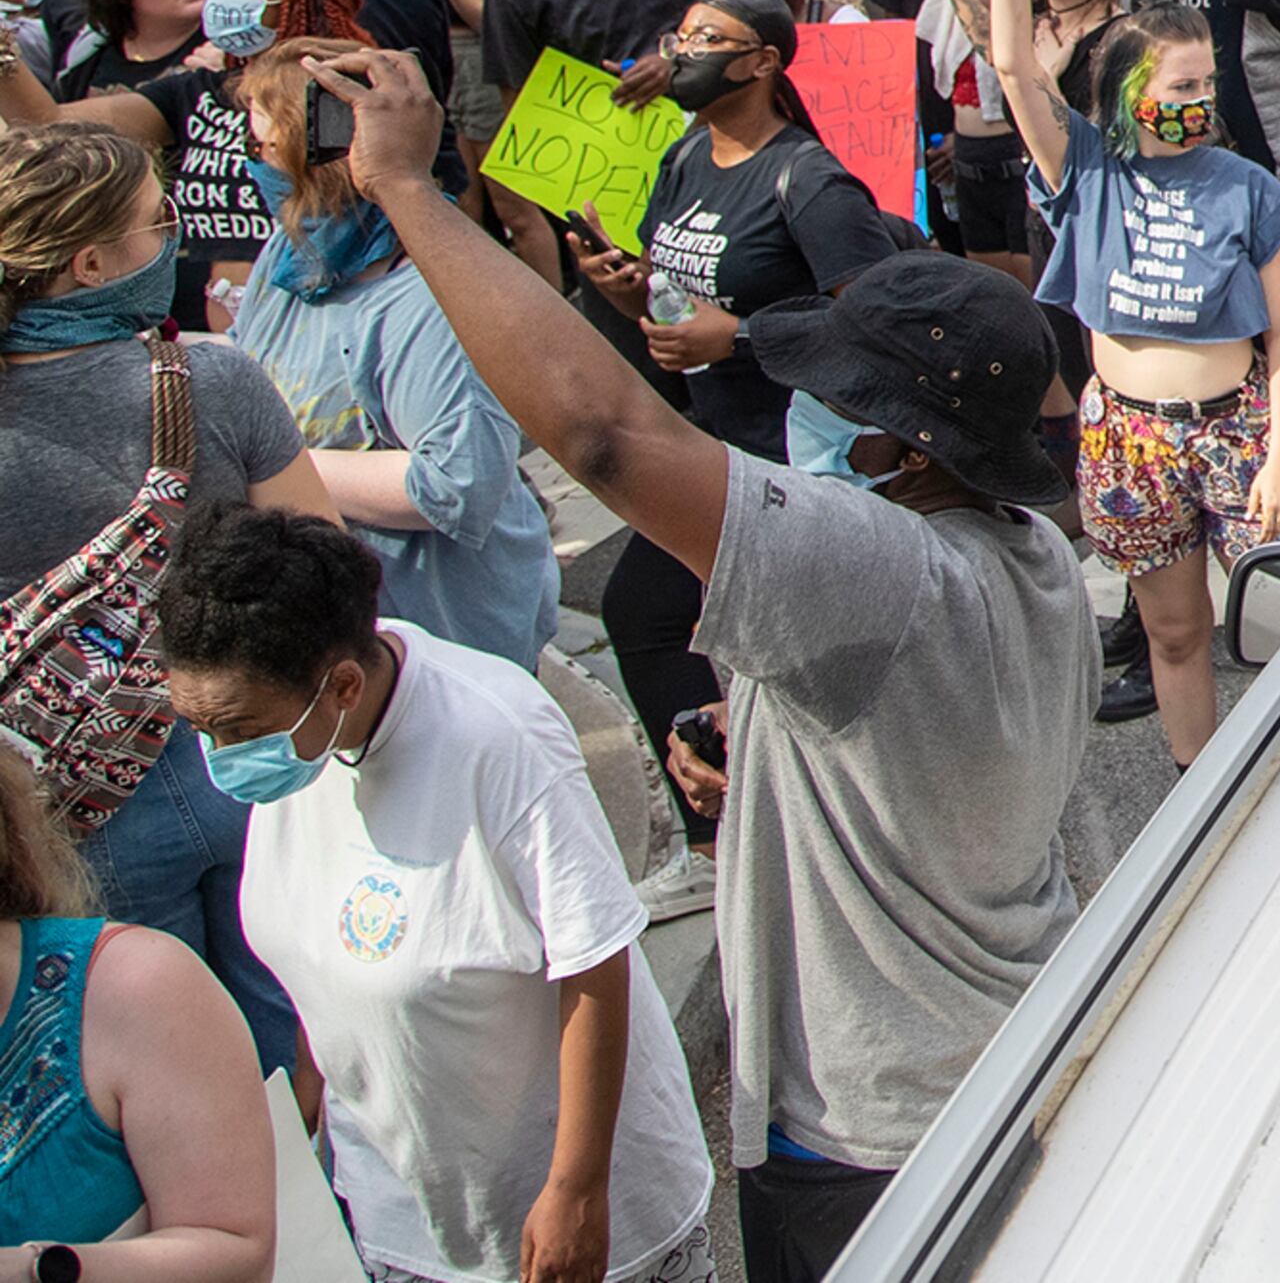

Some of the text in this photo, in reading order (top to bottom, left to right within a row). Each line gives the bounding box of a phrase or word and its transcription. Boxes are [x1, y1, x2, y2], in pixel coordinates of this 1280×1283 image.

[791, 27, 895, 67] END
[548, 64, 617, 126] NO
[499, 123, 573, 176] NO
[238, 184, 260, 210] &
[180, 213, 276, 240] FREDD
[672, 198, 702, 228] I
[651, 222, 728, 256] TALENTED
[1147, 222, 1206, 246] something
[650, 243, 721, 278] CREATIVE
[1131, 258, 1184, 280] problem
[1108, 267, 1159, 300] because
[1160, 282, 1172, 299] it
[1141, 304, 1198, 324] problem
